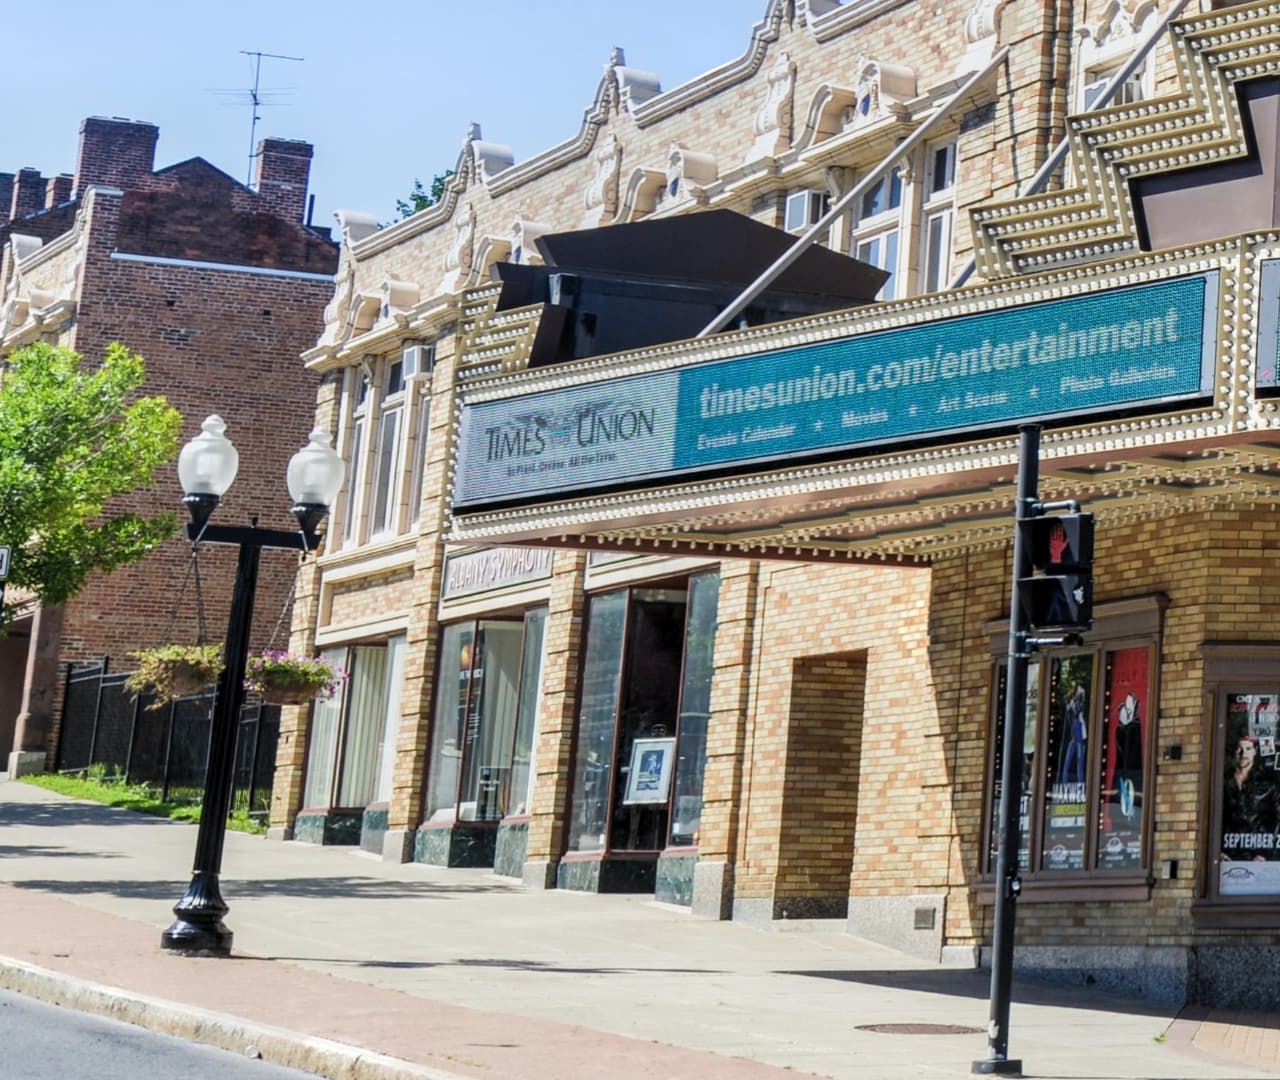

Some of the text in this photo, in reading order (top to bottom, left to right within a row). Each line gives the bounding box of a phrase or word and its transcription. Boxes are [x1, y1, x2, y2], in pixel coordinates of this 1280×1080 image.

[700, 308, 1179, 418] timesunion.com/entertainment
[841, 407, 889, 428] Movies
[937, 395, 961, 414] Art
[485, 407, 656, 463] TIMES UNION
[449, 547, 551, 591] ALBANY SYMPHONY
[1224, 832, 1274, 849] SEPTEMBER
